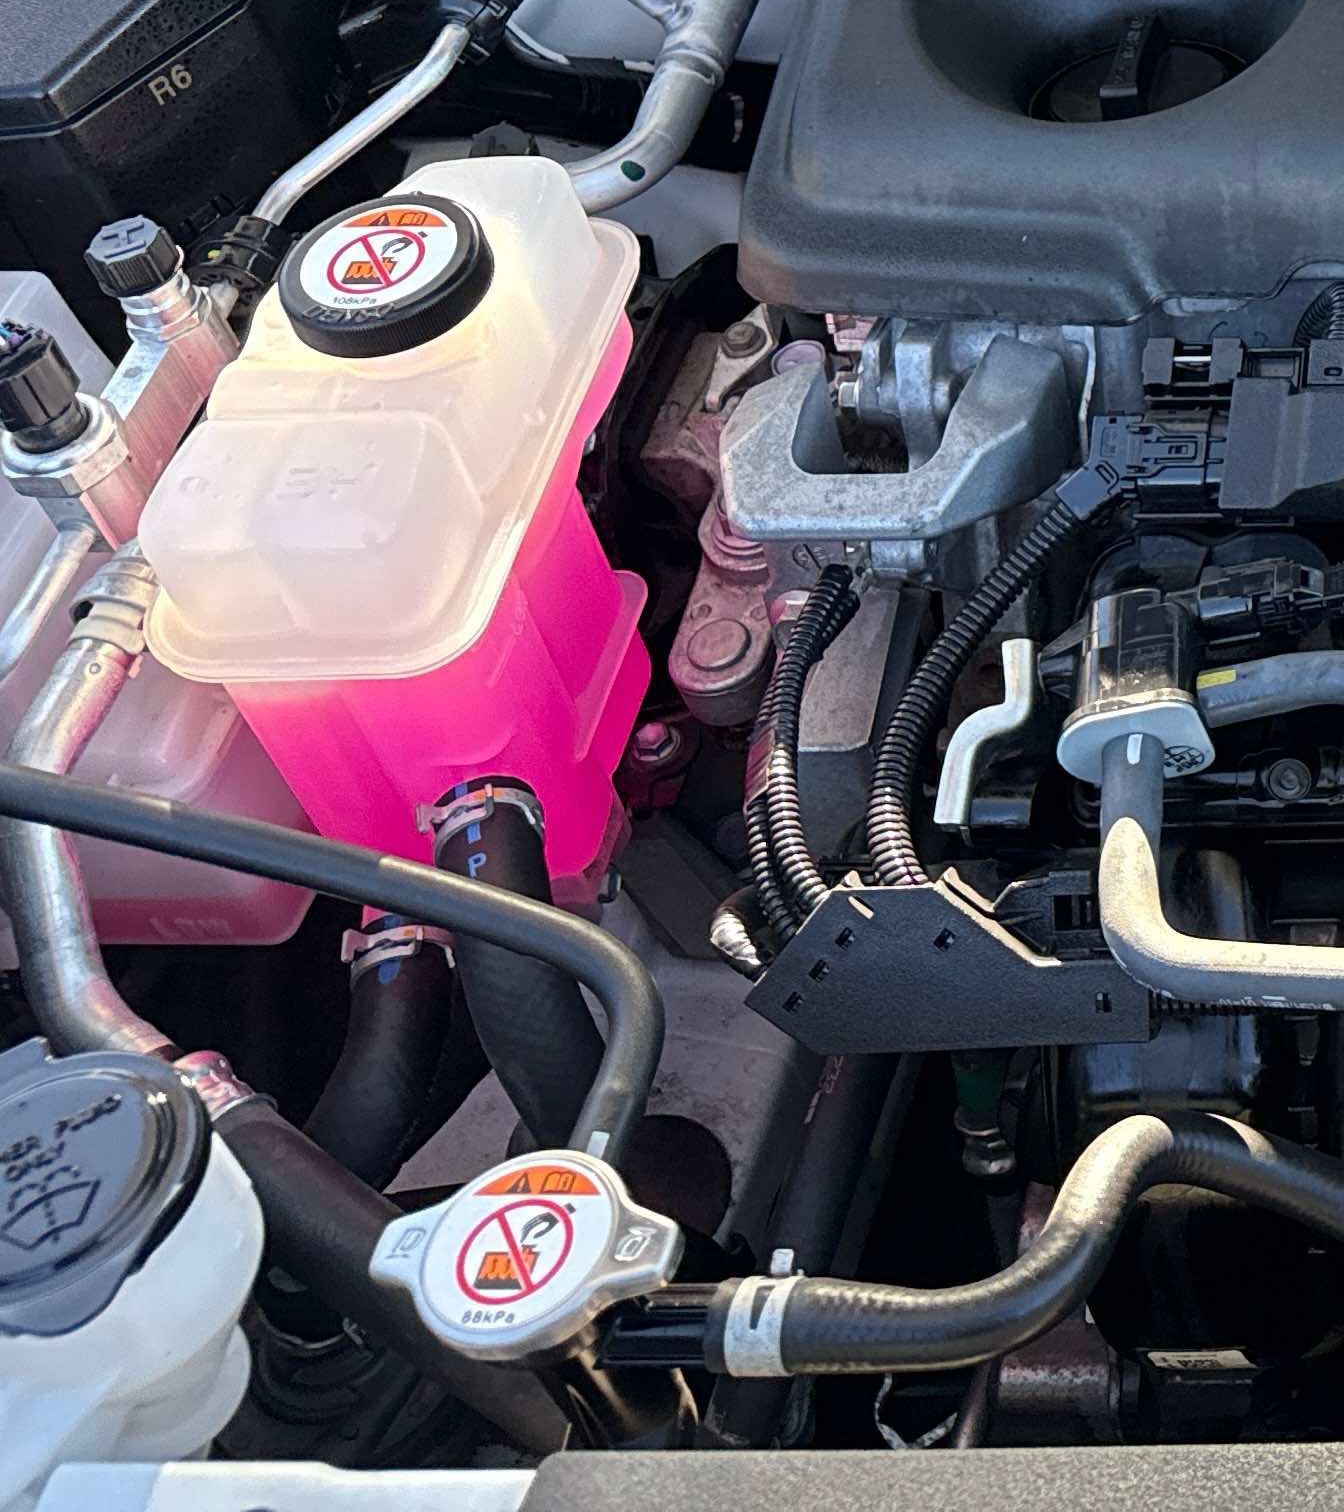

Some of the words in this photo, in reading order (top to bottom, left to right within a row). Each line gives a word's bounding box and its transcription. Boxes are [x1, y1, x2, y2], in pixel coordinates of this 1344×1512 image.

[148, 64, 192, 106] R6
[332, 296, 377, 305] 108kPa
[460, 1309, 516, 1326] 88kPa
